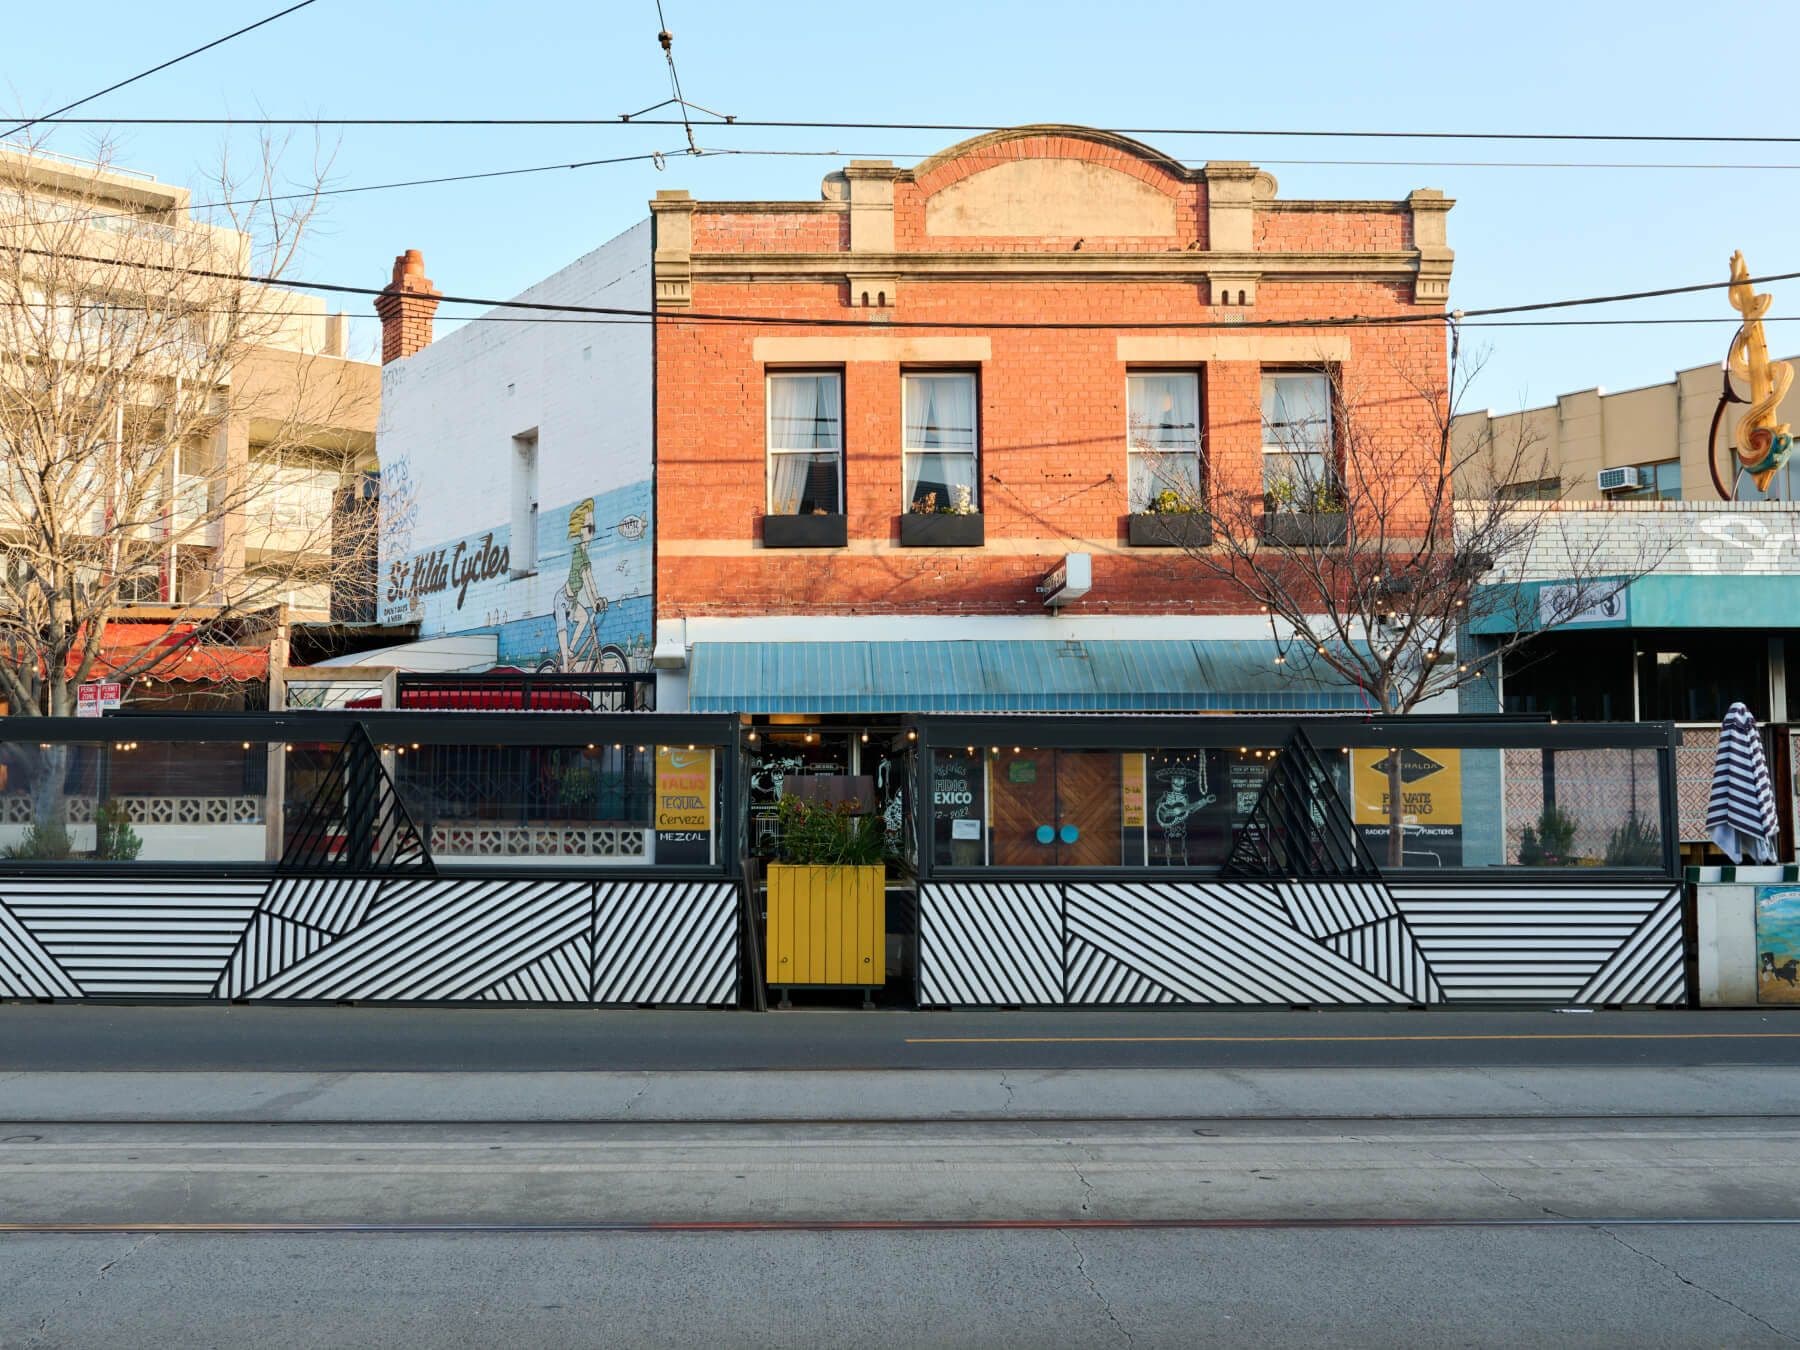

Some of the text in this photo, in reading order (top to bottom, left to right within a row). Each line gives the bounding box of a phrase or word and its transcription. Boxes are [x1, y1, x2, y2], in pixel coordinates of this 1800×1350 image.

[408, 549, 449, 598] Kilda
[452, 532, 510, 610] Cycles
[660, 773, 706, 791] TACOS
[934, 791, 972, 804] EXICO
[1382, 793, 1431, 803] PVATE
[1382, 804, 1433, 814] DING
[660, 813, 704, 825] Cerveza
[660, 832, 706, 841] MEZCAL
